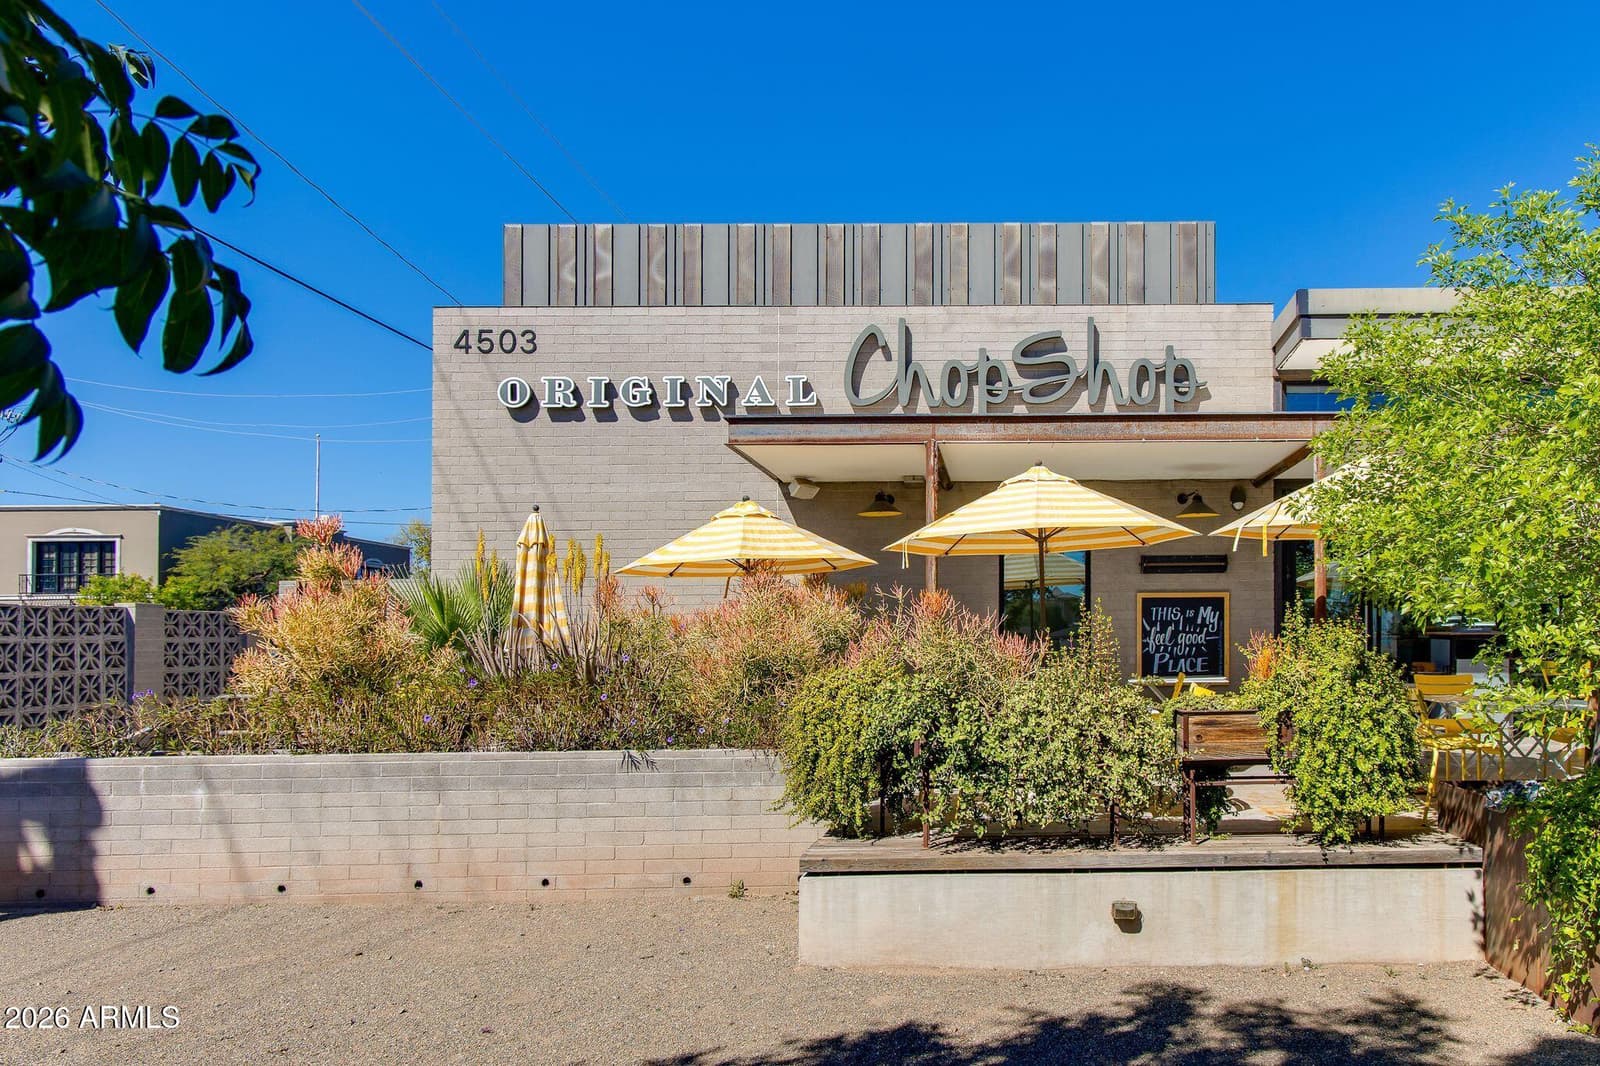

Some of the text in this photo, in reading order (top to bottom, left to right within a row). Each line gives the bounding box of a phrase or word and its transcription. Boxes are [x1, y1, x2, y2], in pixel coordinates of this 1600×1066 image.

[453, 329, 538, 355] 4503
[497, 375, 817, 409] ORIGINAL
[1150, 606, 1181, 621] THIS
[1147, 626, 1207, 656] feel good
